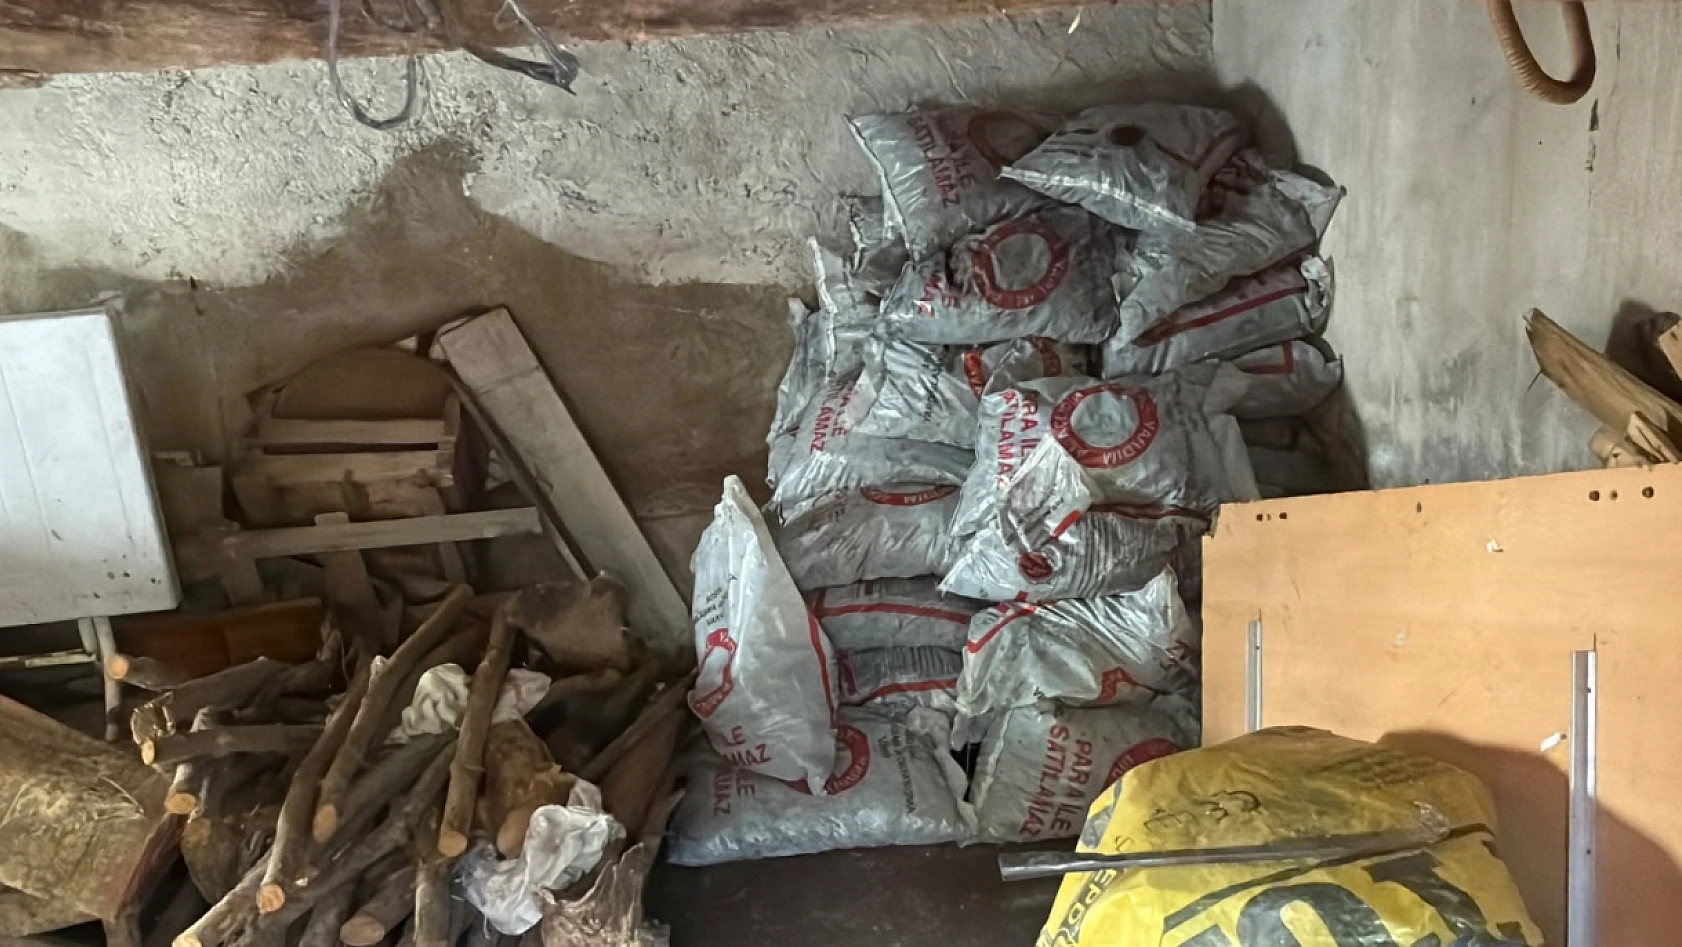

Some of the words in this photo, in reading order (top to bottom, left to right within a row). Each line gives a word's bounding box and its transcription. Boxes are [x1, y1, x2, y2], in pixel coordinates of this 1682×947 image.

[1019, 725, 1071, 837] SATILAMAZ
[1068, 739, 1093, 799] PARA
[1050, 803, 1084, 832] ILE
